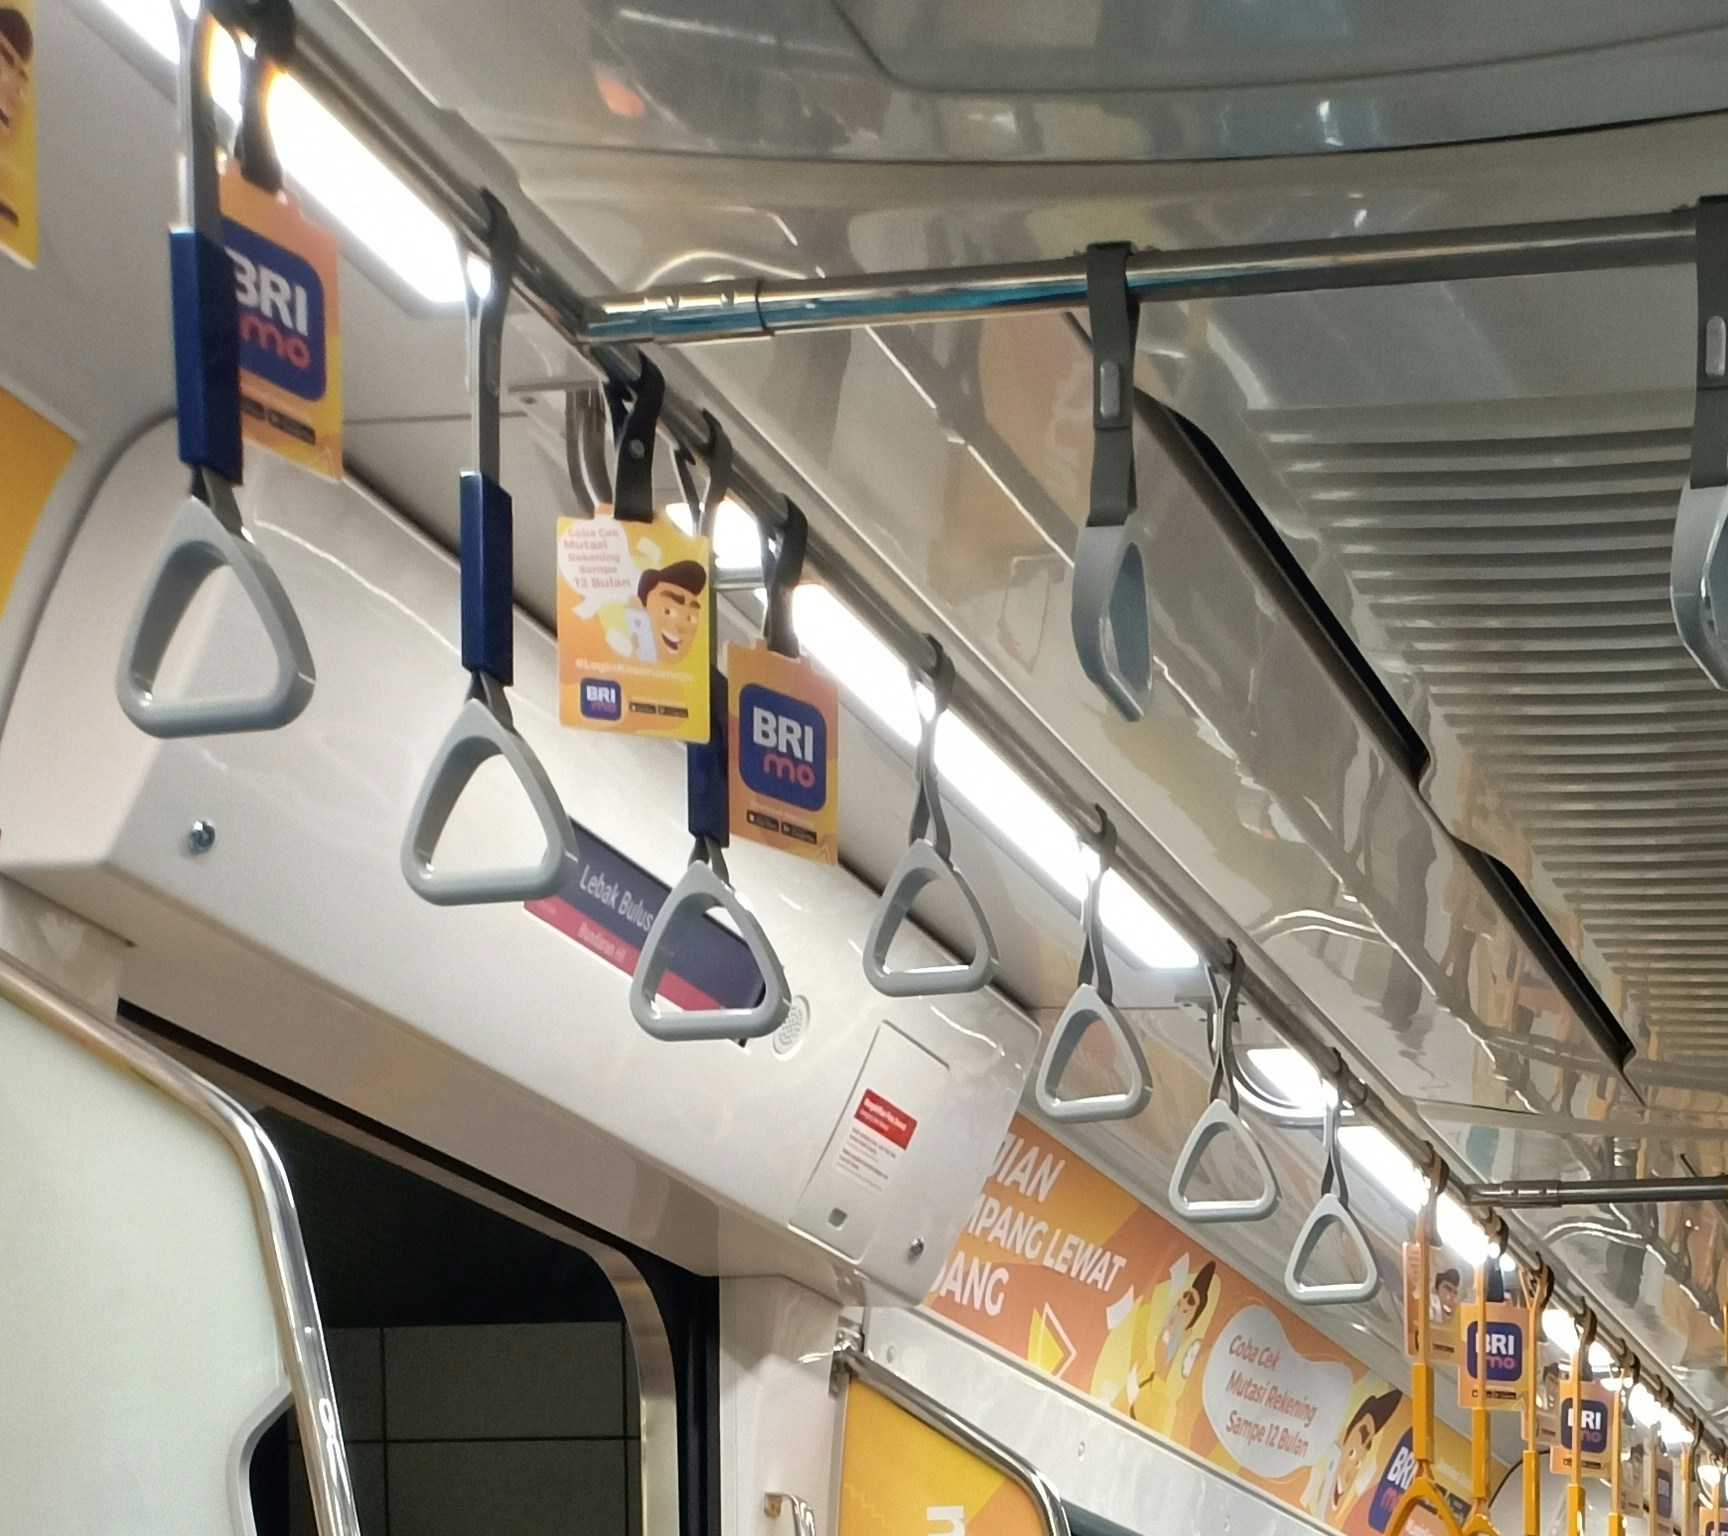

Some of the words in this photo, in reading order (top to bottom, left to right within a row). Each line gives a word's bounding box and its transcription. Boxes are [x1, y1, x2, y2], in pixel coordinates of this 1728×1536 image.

[586, 685, 616, 703] BRI
[753, 706, 814, 763] BRI
[763, 752, 816, 789] mo
[579, 864, 621, 911] Lebak
[617, 891, 654, 932] Bulus
[1043, 1228, 1128, 1293] LEWAT
[1229, 1334, 1257, 1363] Coba
[1256, 1345, 1281, 1371] Cek
[1226, 1370, 1267, 1403] Mutasi
[1264, 1383, 1319, 1428] Rekening
[1226, 1410, 1267, 1445] Sampe
[1266, 1423, 1278, 1447] 12
[1276, 1427, 1310, 1459] Bulan
